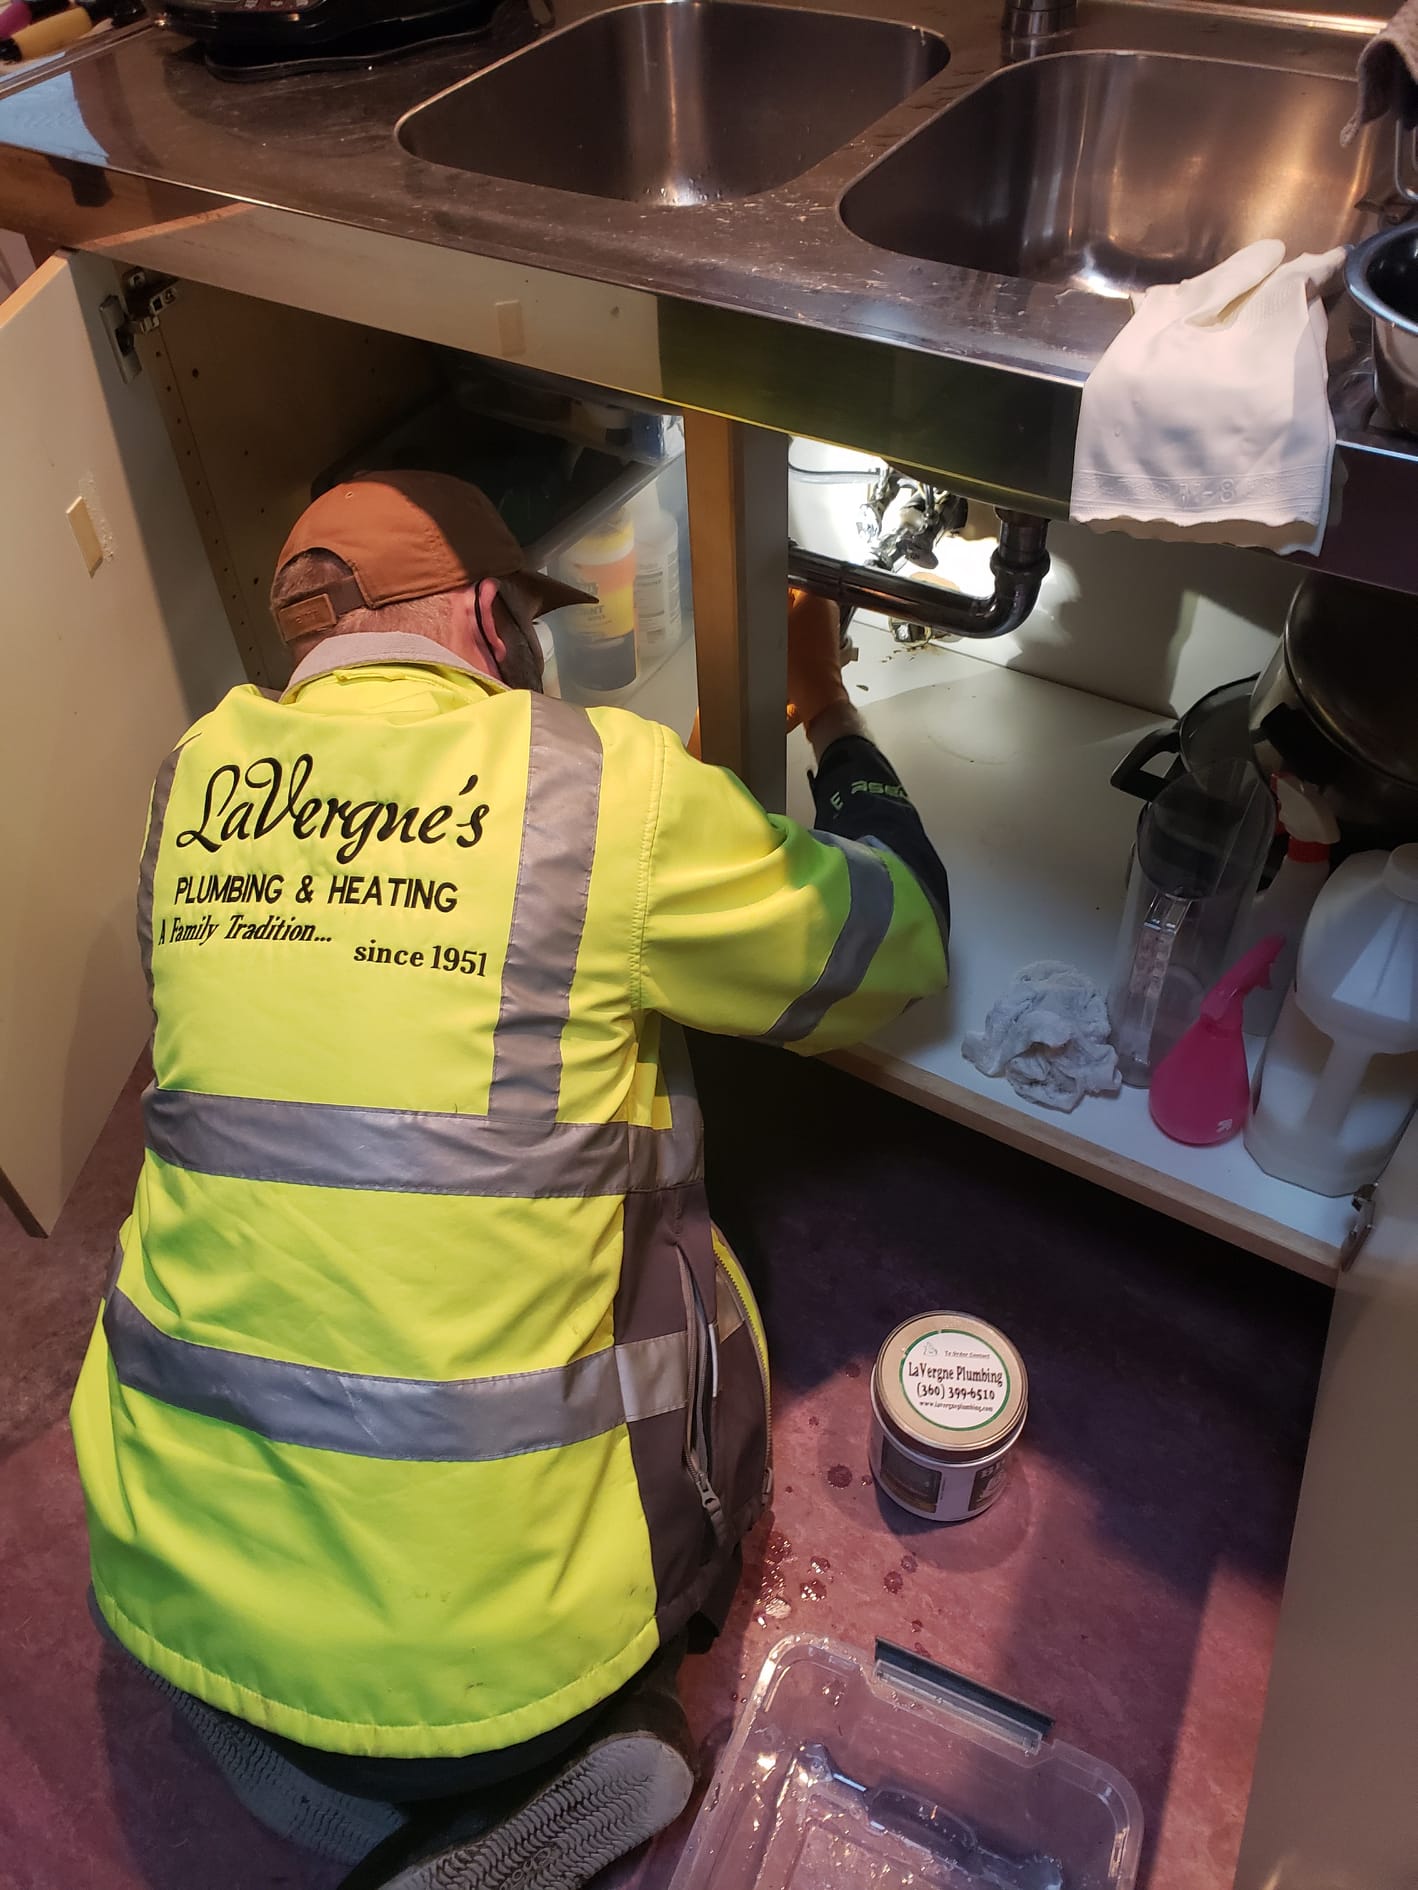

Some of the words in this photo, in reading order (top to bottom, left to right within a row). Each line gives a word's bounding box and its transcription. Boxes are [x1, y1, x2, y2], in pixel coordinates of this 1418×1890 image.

[176, 753, 490, 865] LaVergne's
[174, 873, 284, 905] PLUMBING
[295, 875, 314, 904] &
[327, 874, 458, 913] HEATING
[158, 919, 167, 946] A
[169, 917, 219, 946] Family
[223, 914, 333, 944] Tradition...
[353, 939, 425, 968] since
[430, 944, 489, 978] 1951
[917, 1382, 945, 1400] (360)
[948, 1386, 995, 1400] 399-6510
[956, 1366, 1003, 1387] Plumbing
